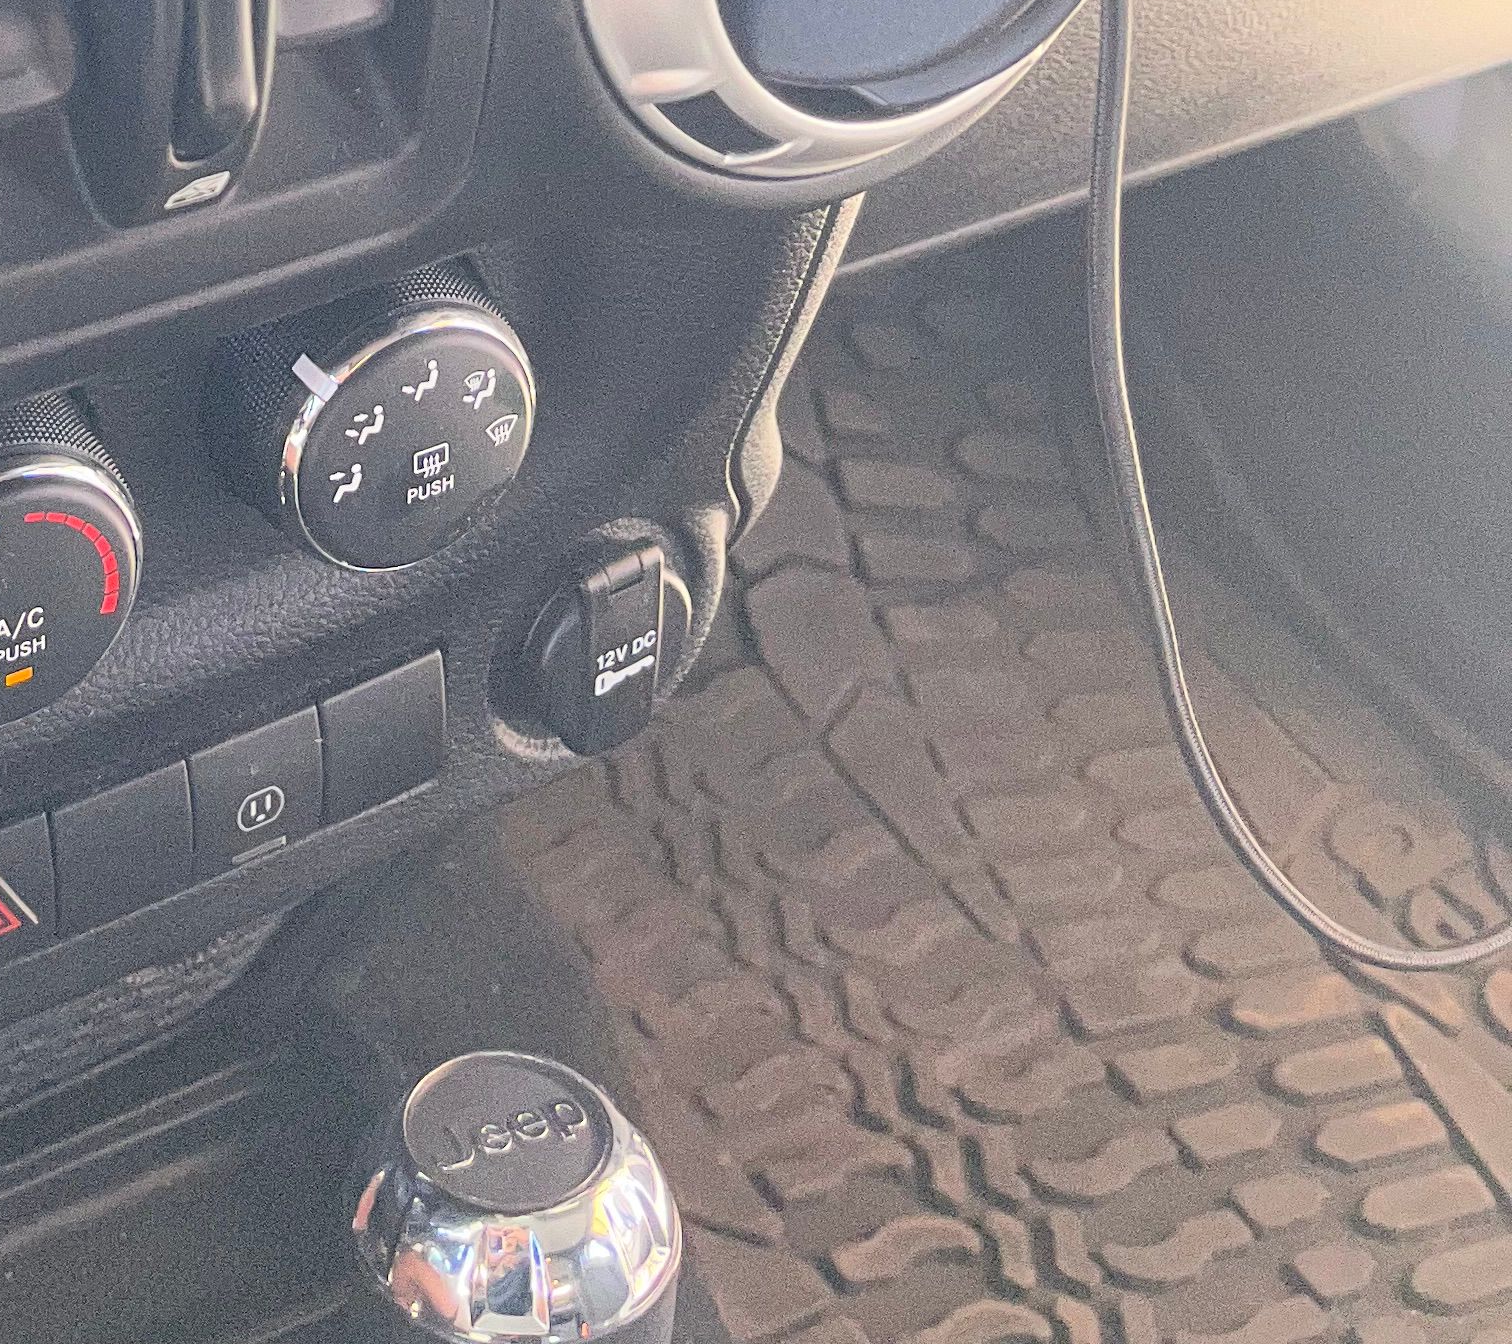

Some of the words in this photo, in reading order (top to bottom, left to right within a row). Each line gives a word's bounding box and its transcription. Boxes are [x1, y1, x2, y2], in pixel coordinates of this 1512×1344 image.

[407, 474, 455, 504] PUSH
[595, 644, 629, 672] 12V
[632, 629, 658, 656] DC
[430, 1102, 589, 1172] Jeep
